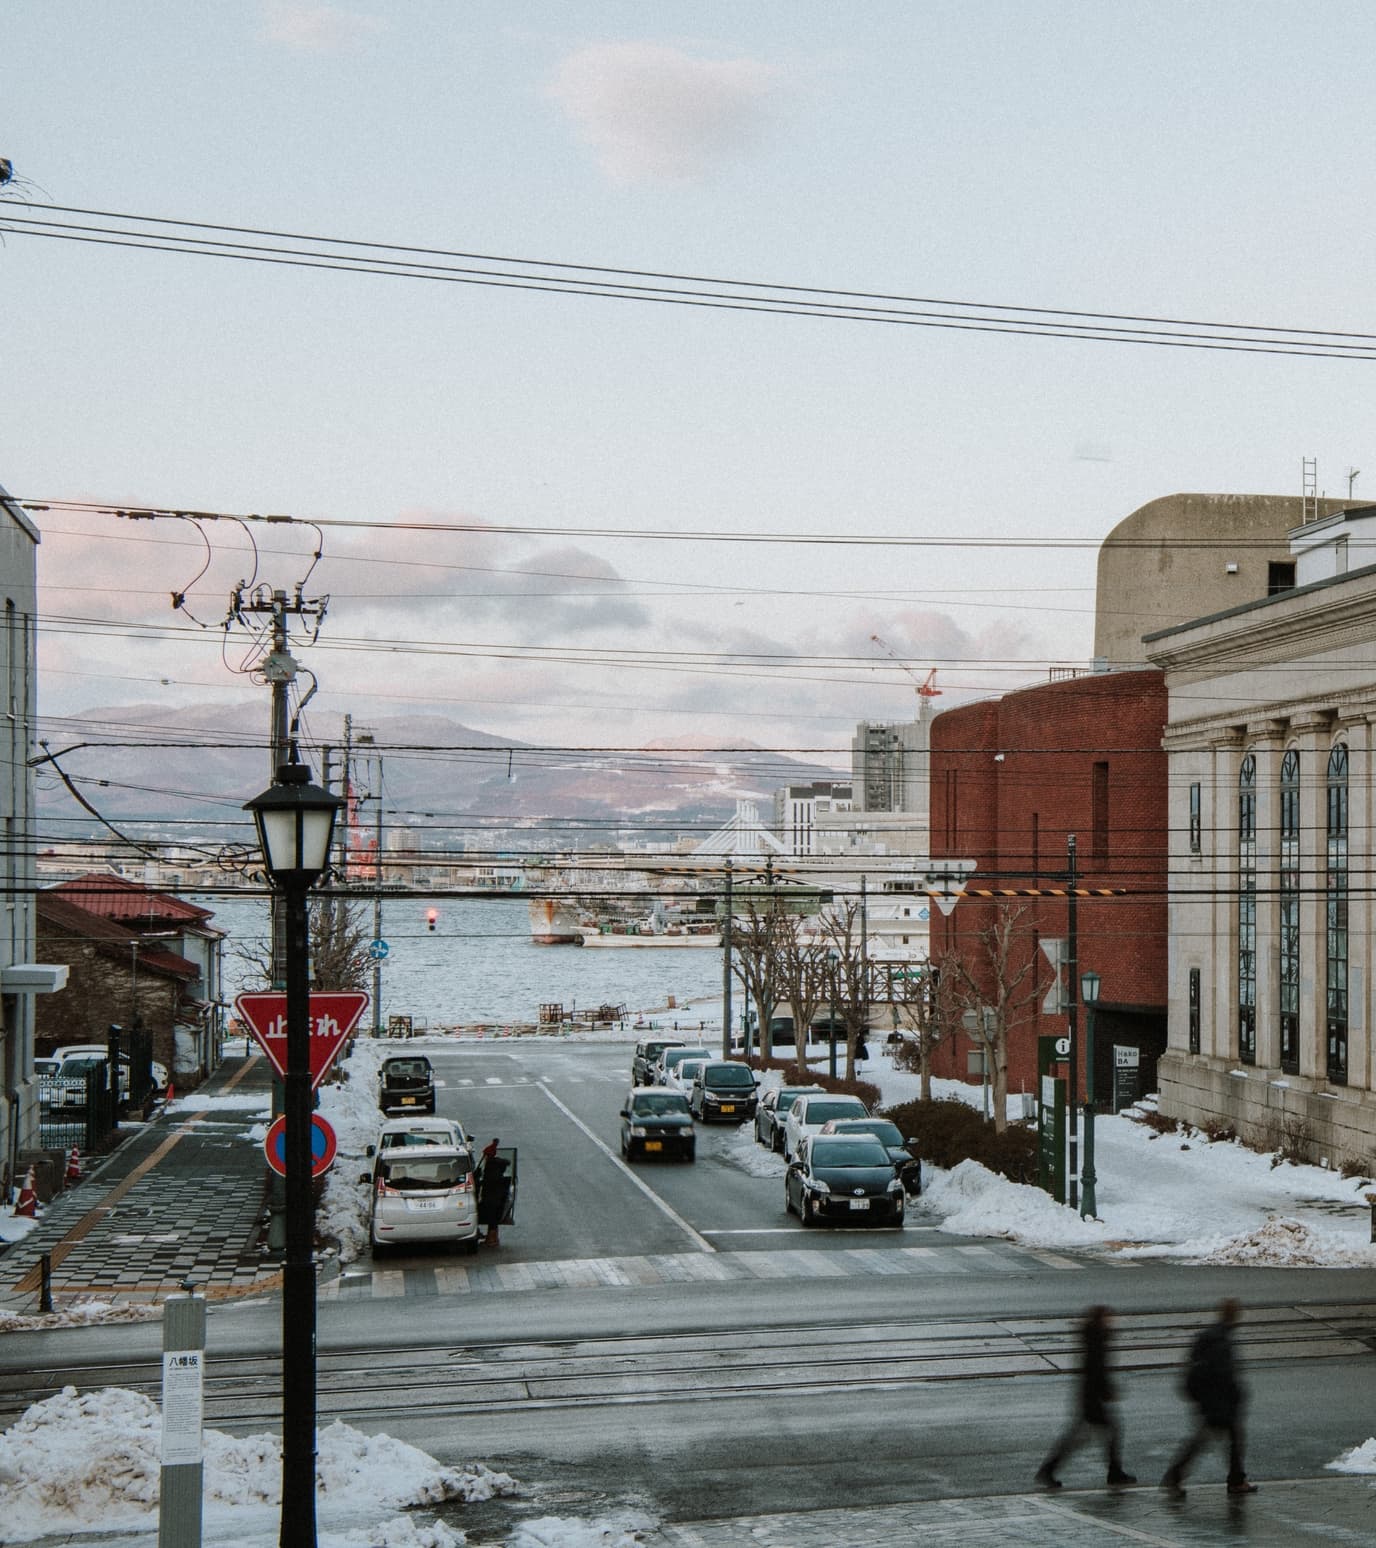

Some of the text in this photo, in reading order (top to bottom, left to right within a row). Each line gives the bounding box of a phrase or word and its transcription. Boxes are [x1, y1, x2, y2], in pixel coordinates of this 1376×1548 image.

[265, 1013, 341, 1039] 止れ
[168, 1355, 198, 1367] 八幡坂
